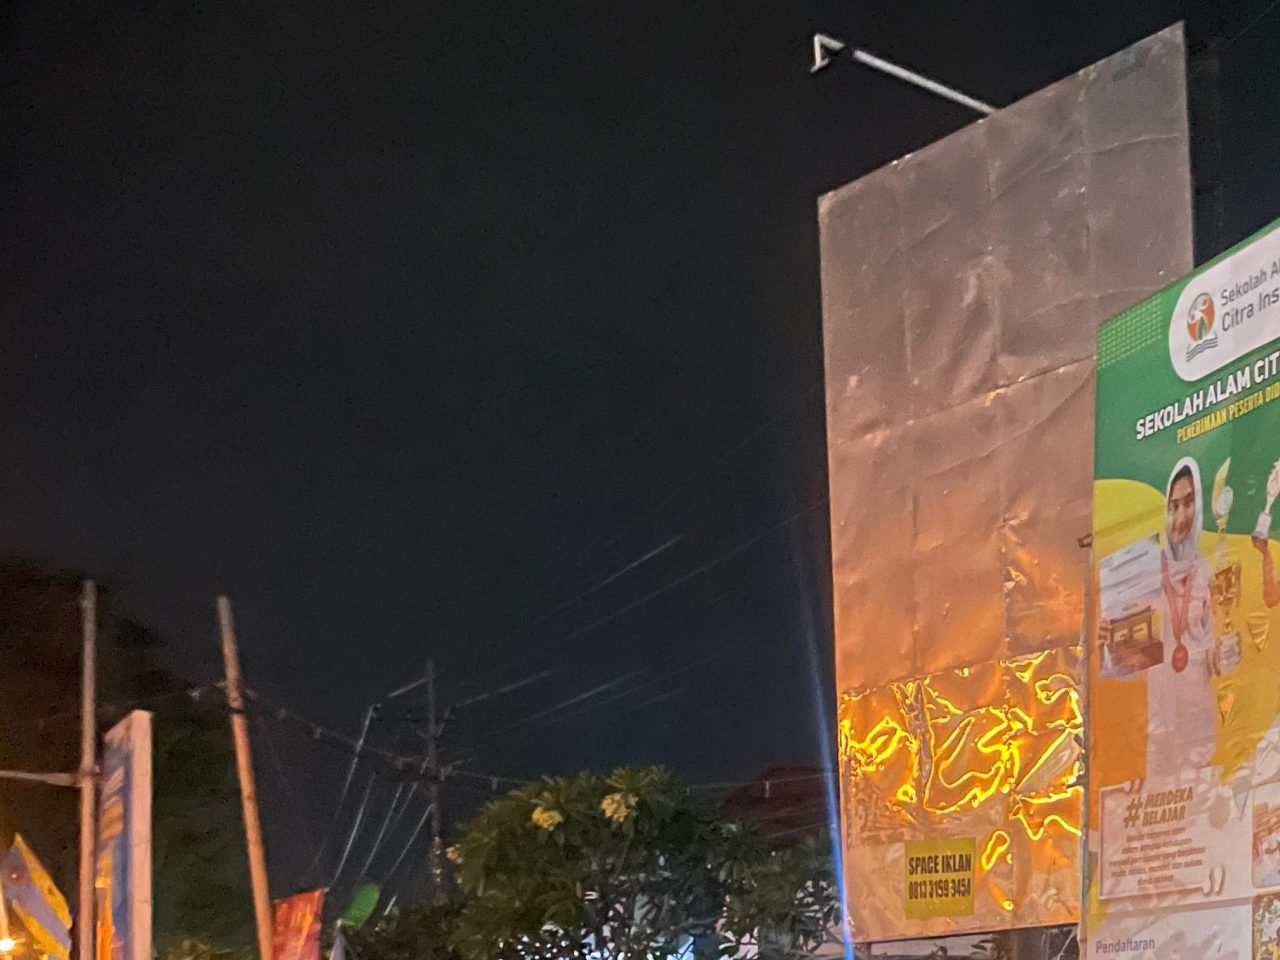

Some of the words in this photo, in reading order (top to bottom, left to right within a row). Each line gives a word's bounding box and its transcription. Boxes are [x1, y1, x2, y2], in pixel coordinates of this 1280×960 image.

[1221, 268, 1267, 306] Sekolah
[1222, 303, 1254, 331] Citra
[1136, 390, 1203, 440] SEKOLAH
[1205, 367, 1251, 408] ALAM
[1177, 408, 1227, 444] PENERIMAAN
[1228, 390, 1264, 420] PESERTA
[1144, 786, 1193, 810] MERDEKA
[1142, 805, 1186, 827] BELAJAR
[908, 855, 940, 876] SPACE
[941, 853, 972, 874] IKLAN
[1095, 938, 1155, 954] Pendaftaran
